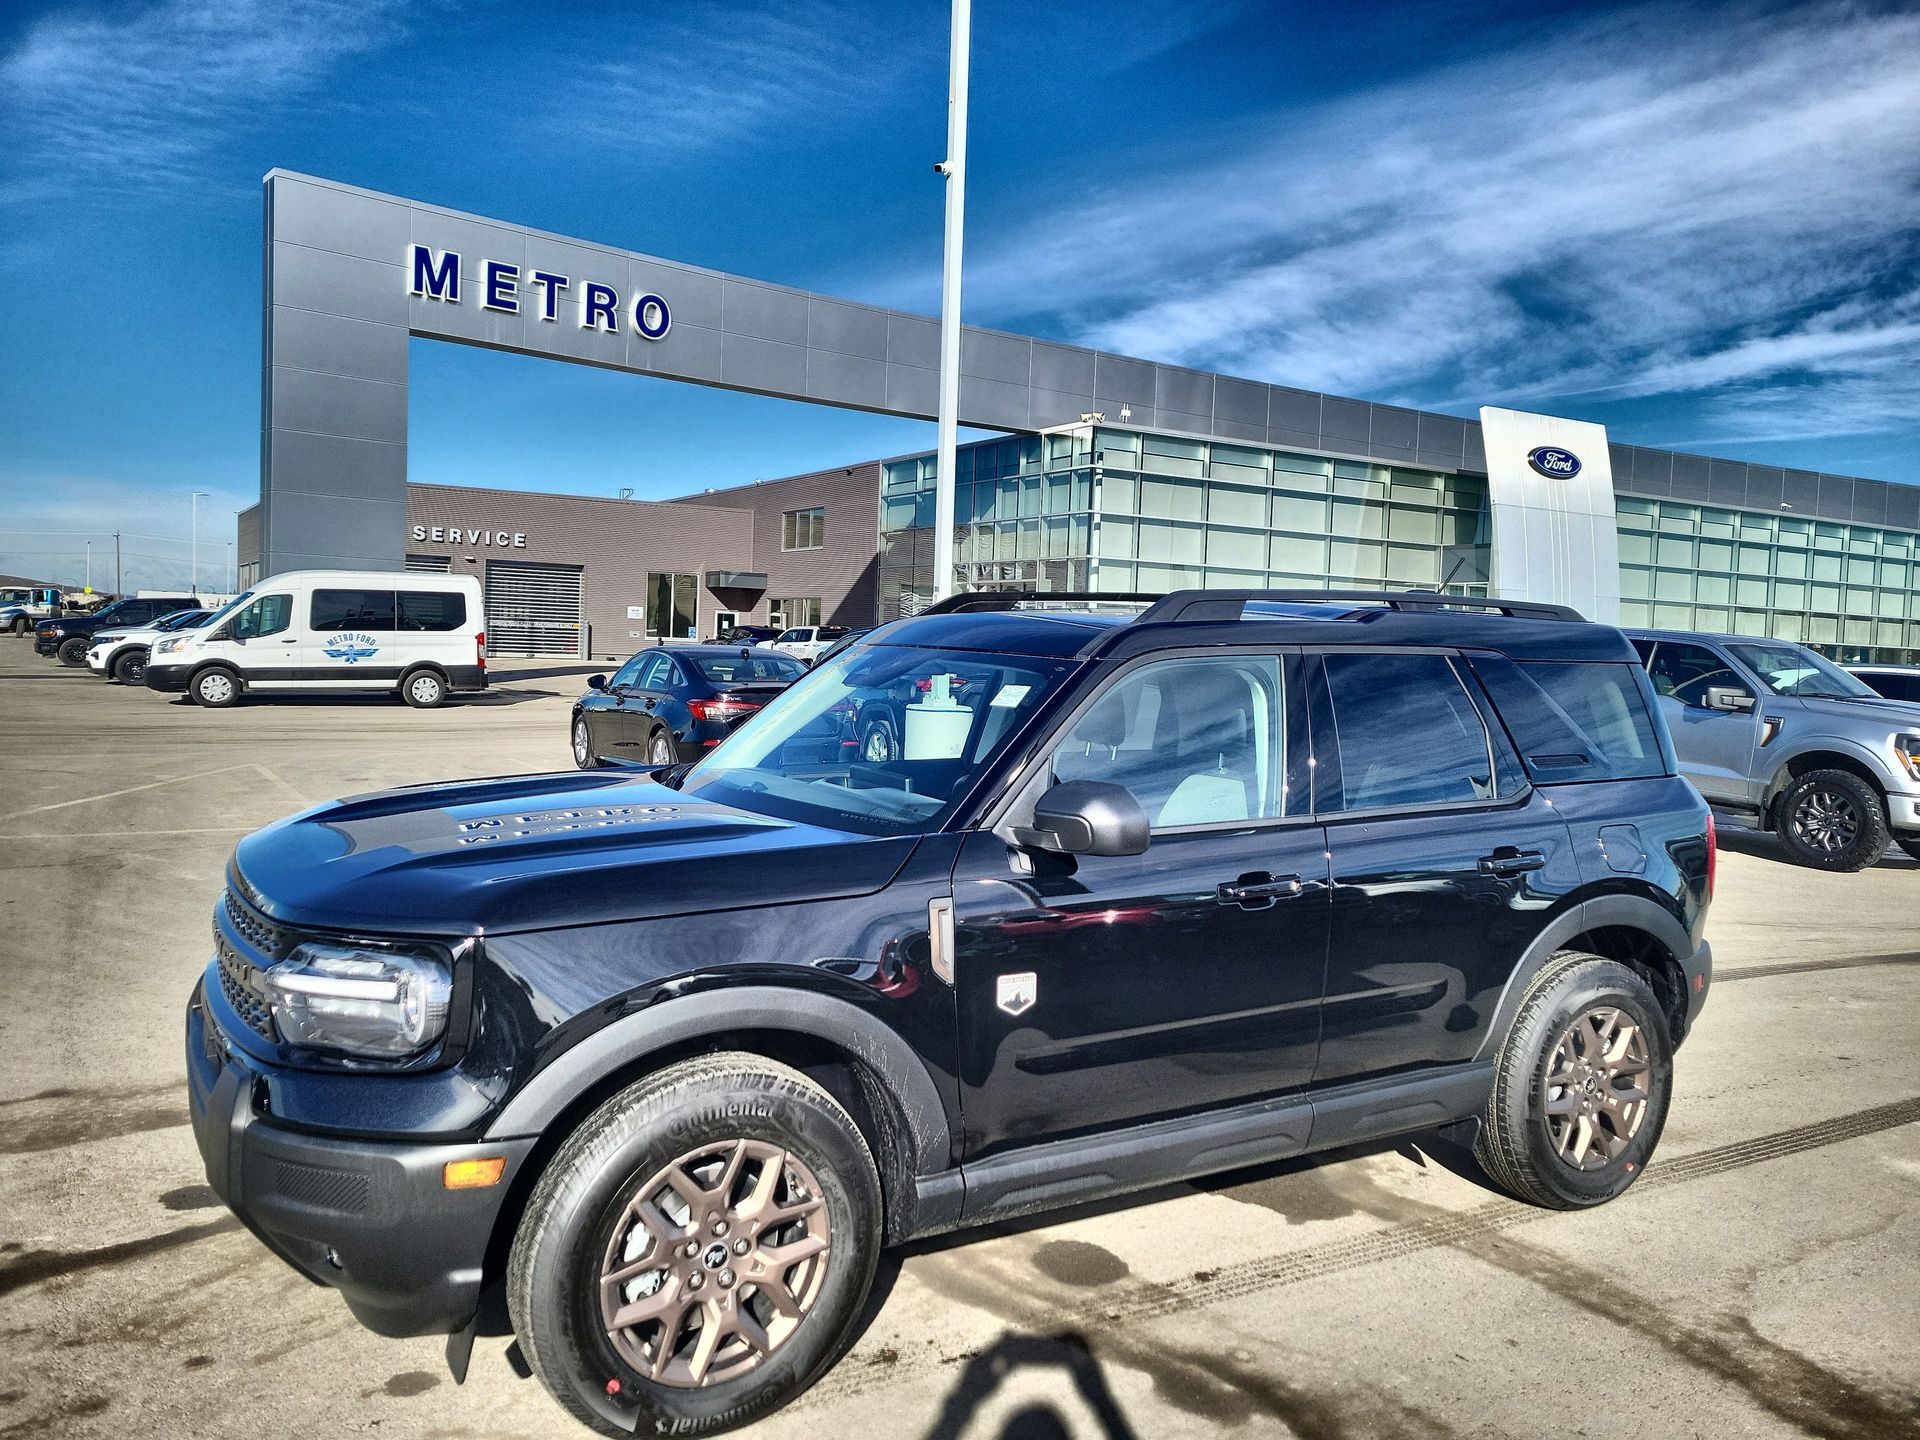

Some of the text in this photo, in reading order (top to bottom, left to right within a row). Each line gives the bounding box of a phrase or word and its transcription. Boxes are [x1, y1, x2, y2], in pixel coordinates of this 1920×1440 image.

[408, 243, 672, 340] METRO
[1544, 451, 1573, 471] Ford
[412, 525, 527, 548] SERVICE
[326, 633, 376, 647] METRO FORD
